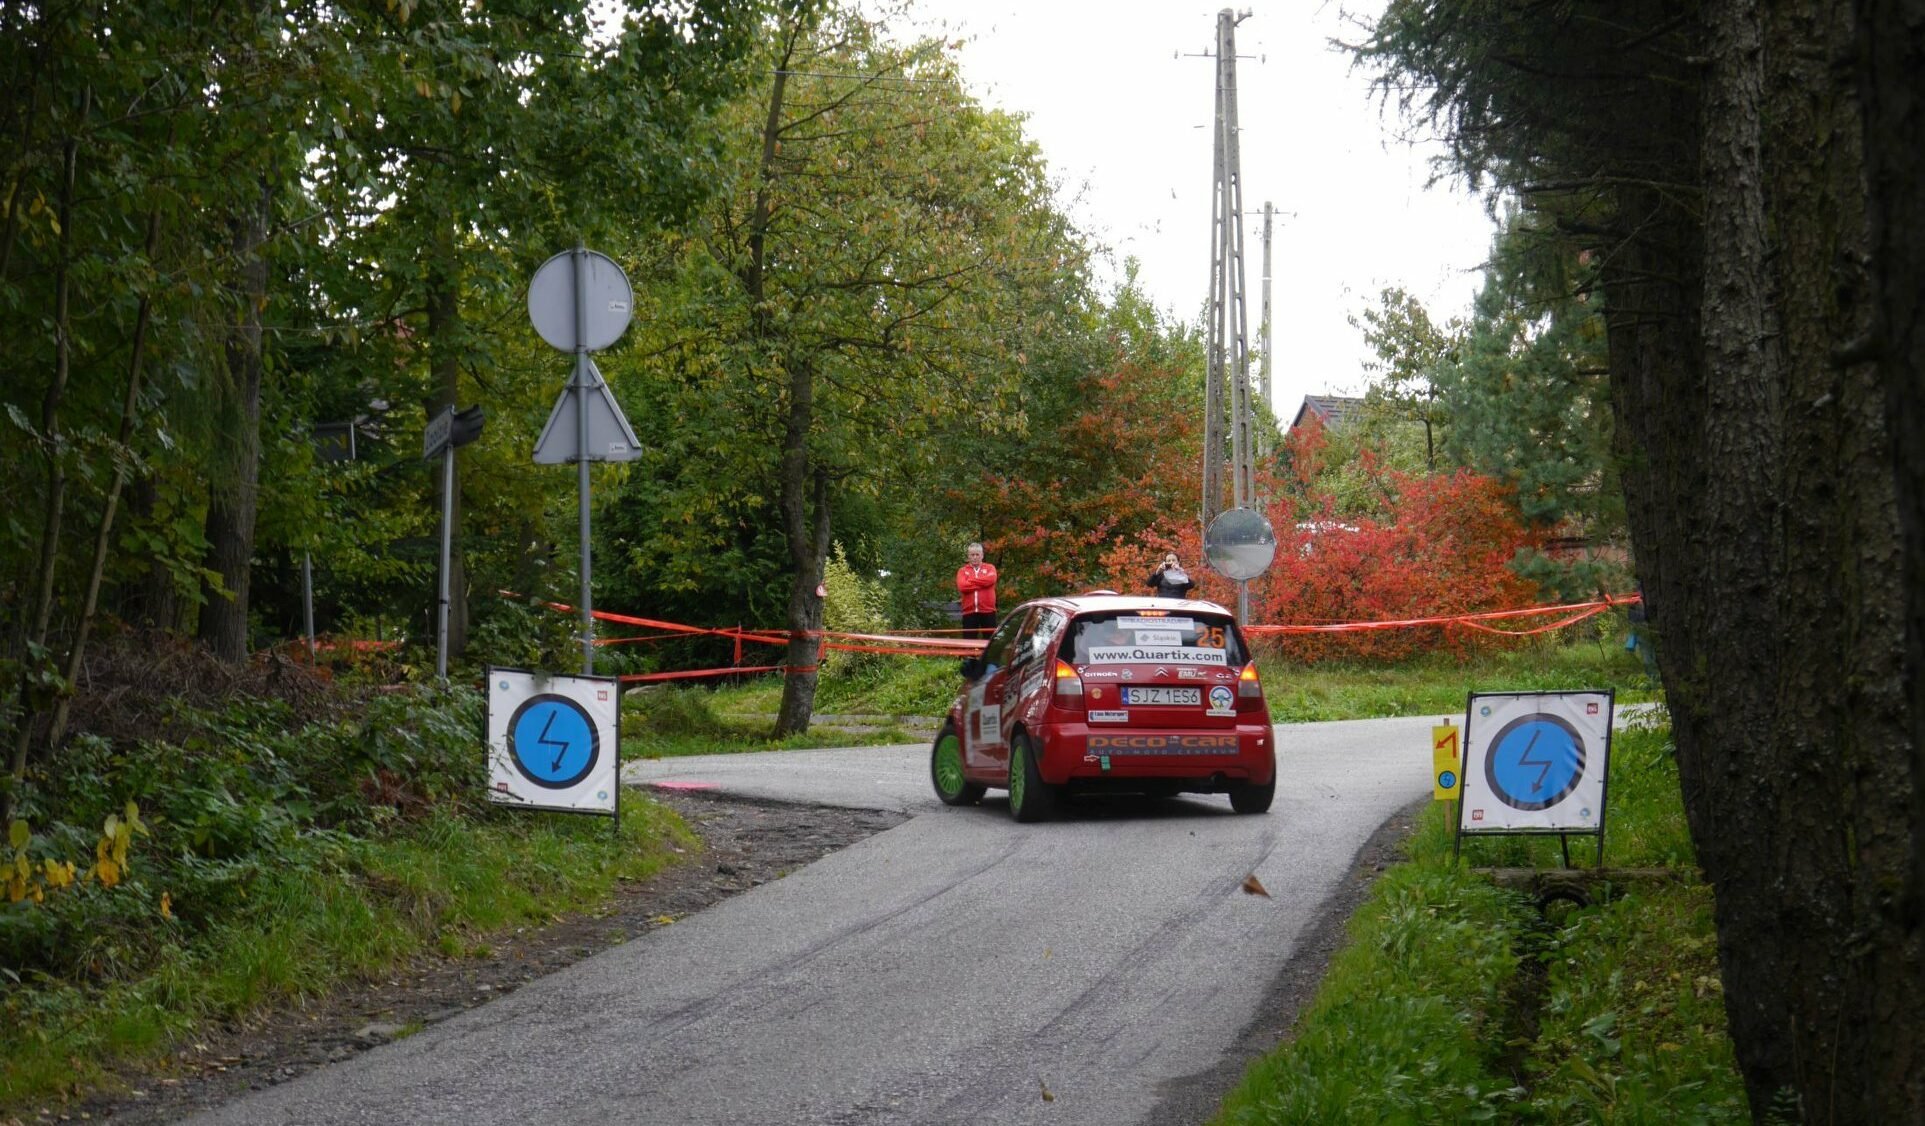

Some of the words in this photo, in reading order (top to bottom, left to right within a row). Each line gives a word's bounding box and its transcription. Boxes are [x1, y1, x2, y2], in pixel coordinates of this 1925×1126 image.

[1196, 625, 1226, 649] 25
[1093, 649, 1223, 662] www.Quartix.com
[1131, 689, 1161, 703] SJZ
[1166, 689, 1198, 704] 1ES6
